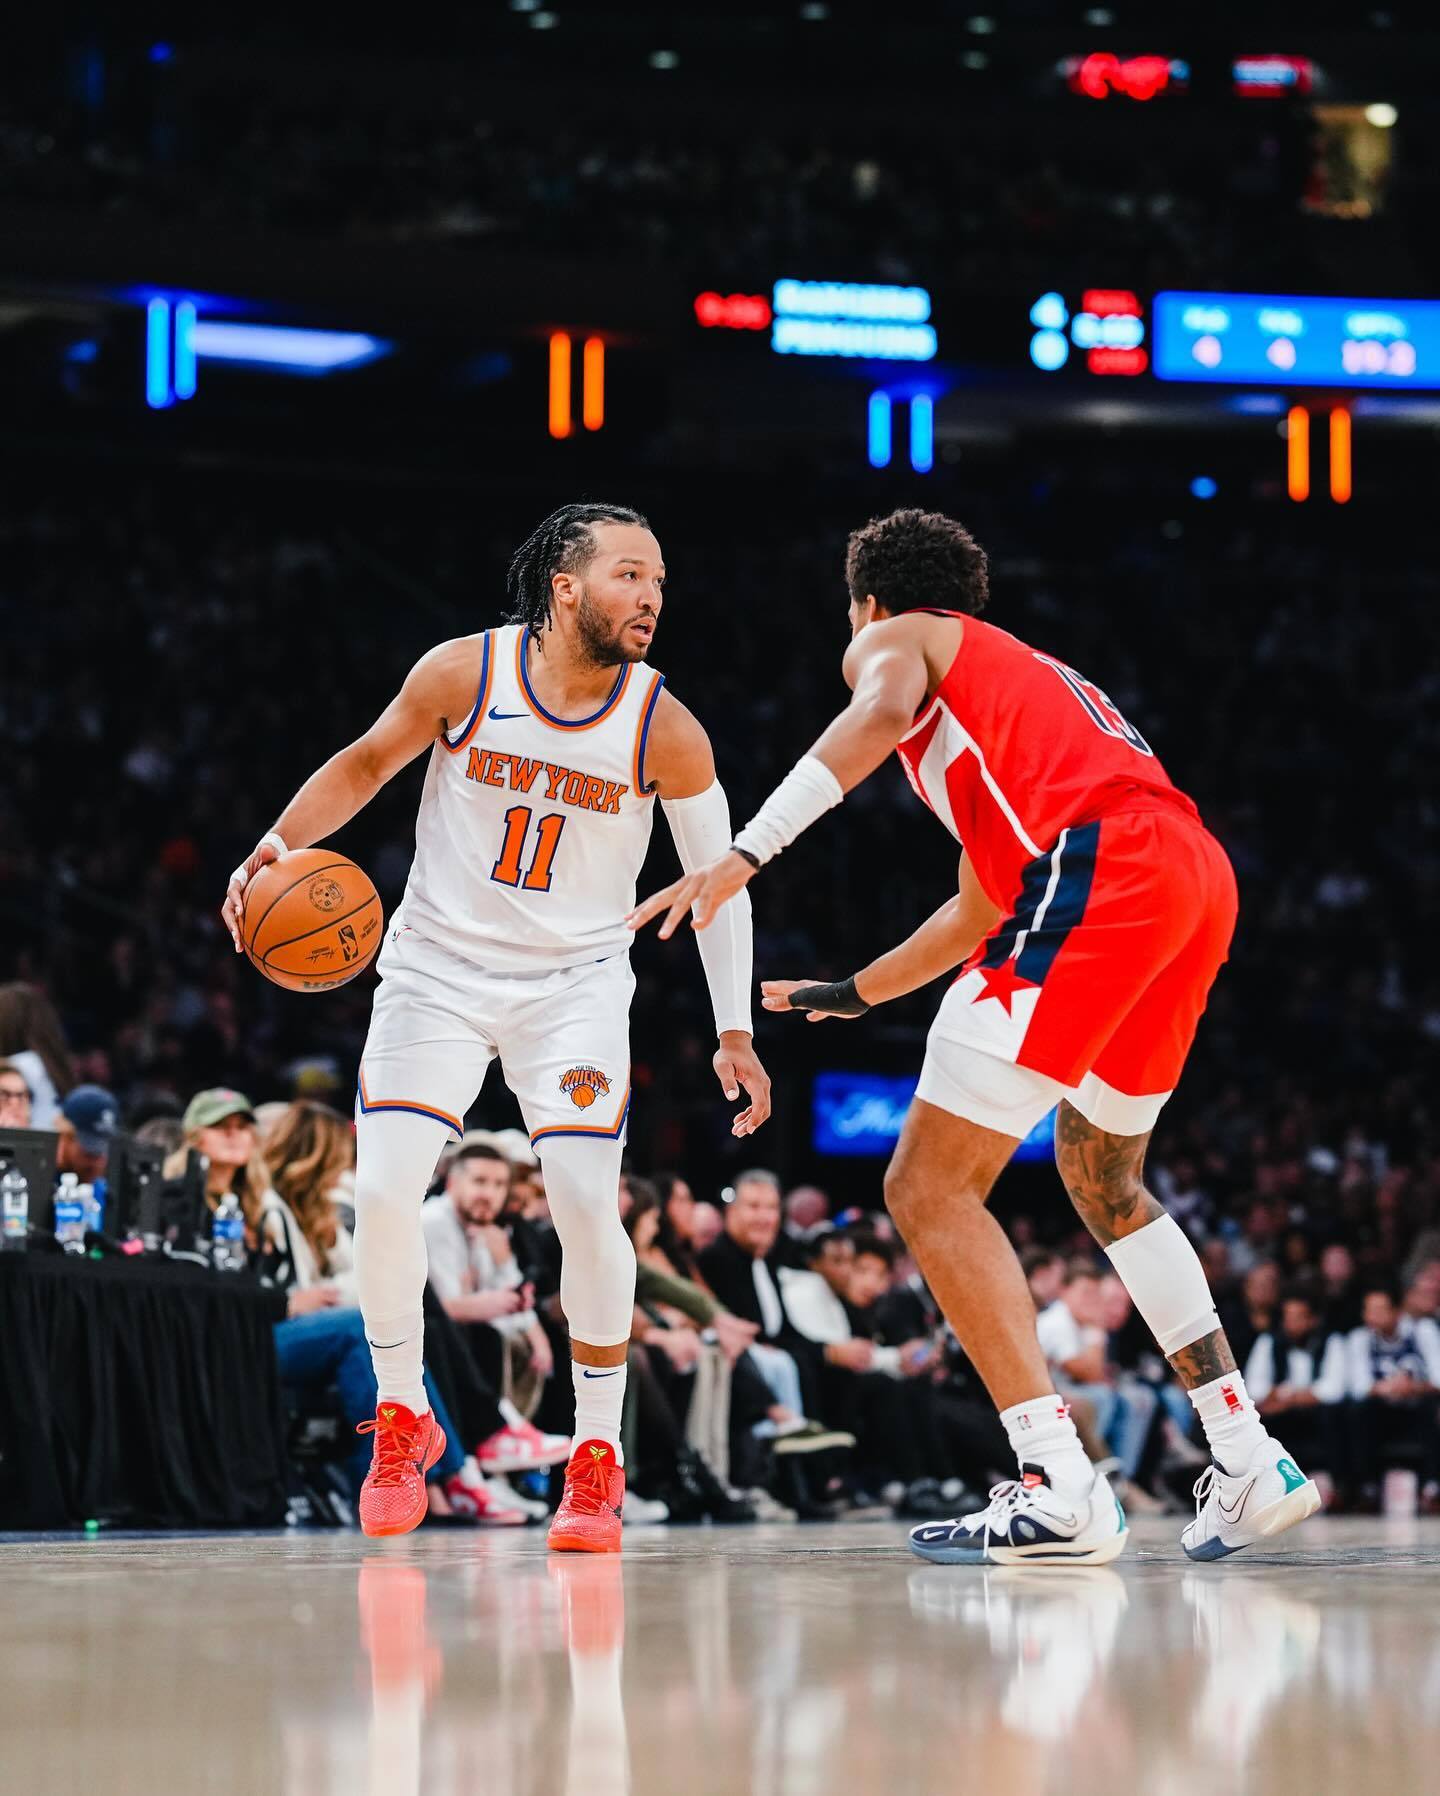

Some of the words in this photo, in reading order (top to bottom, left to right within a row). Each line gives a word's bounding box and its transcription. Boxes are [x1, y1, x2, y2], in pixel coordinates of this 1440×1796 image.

[466, 747, 543, 793] NEW
[544, 763, 628, 815] YORK
[490, 805, 567, 892] 11
[559, 1069, 610, 1097] KNICKS
